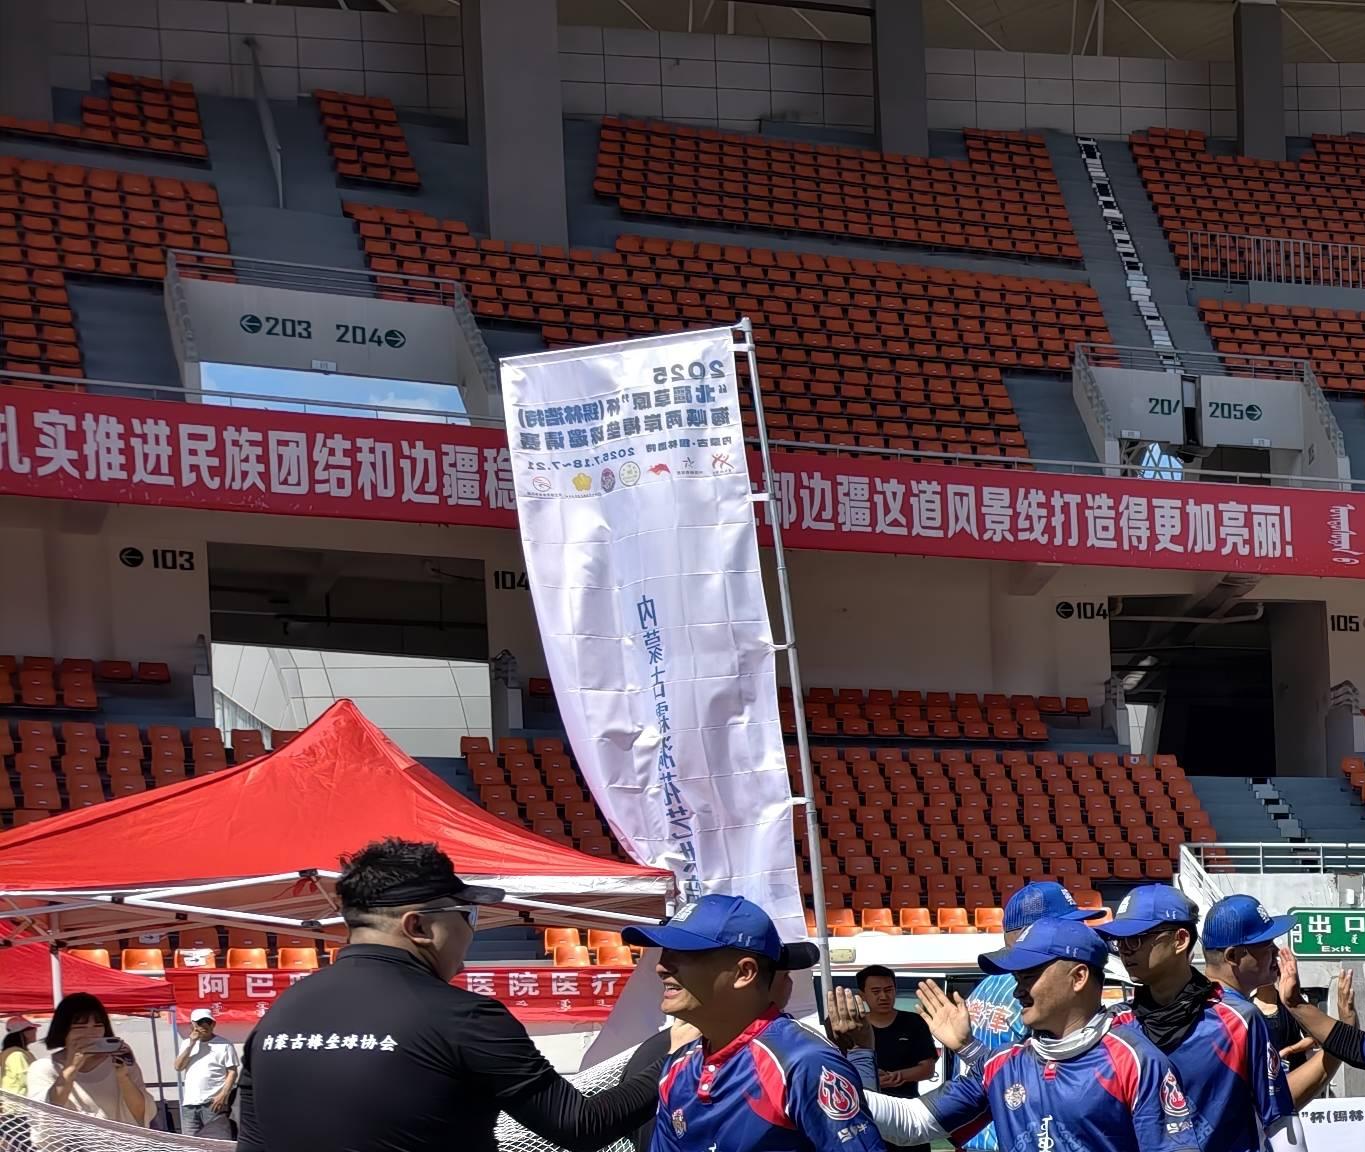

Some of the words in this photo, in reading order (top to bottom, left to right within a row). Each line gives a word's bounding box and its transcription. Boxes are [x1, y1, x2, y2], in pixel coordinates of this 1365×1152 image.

[265, 316, 312, 340] 203
[335, 324, 384, 348] 204
[1208, 401, 1245, 420] 205
[152, 548, 195, 571] 103
[1076, 602, 1108, 620] 104
[1329, 615, 1361, 633] 105
[1308, 914, 1365, 934] 出口
[1321, 945, 1352, 953] Exit
[465, 971, 622, 997] 医院医疗
